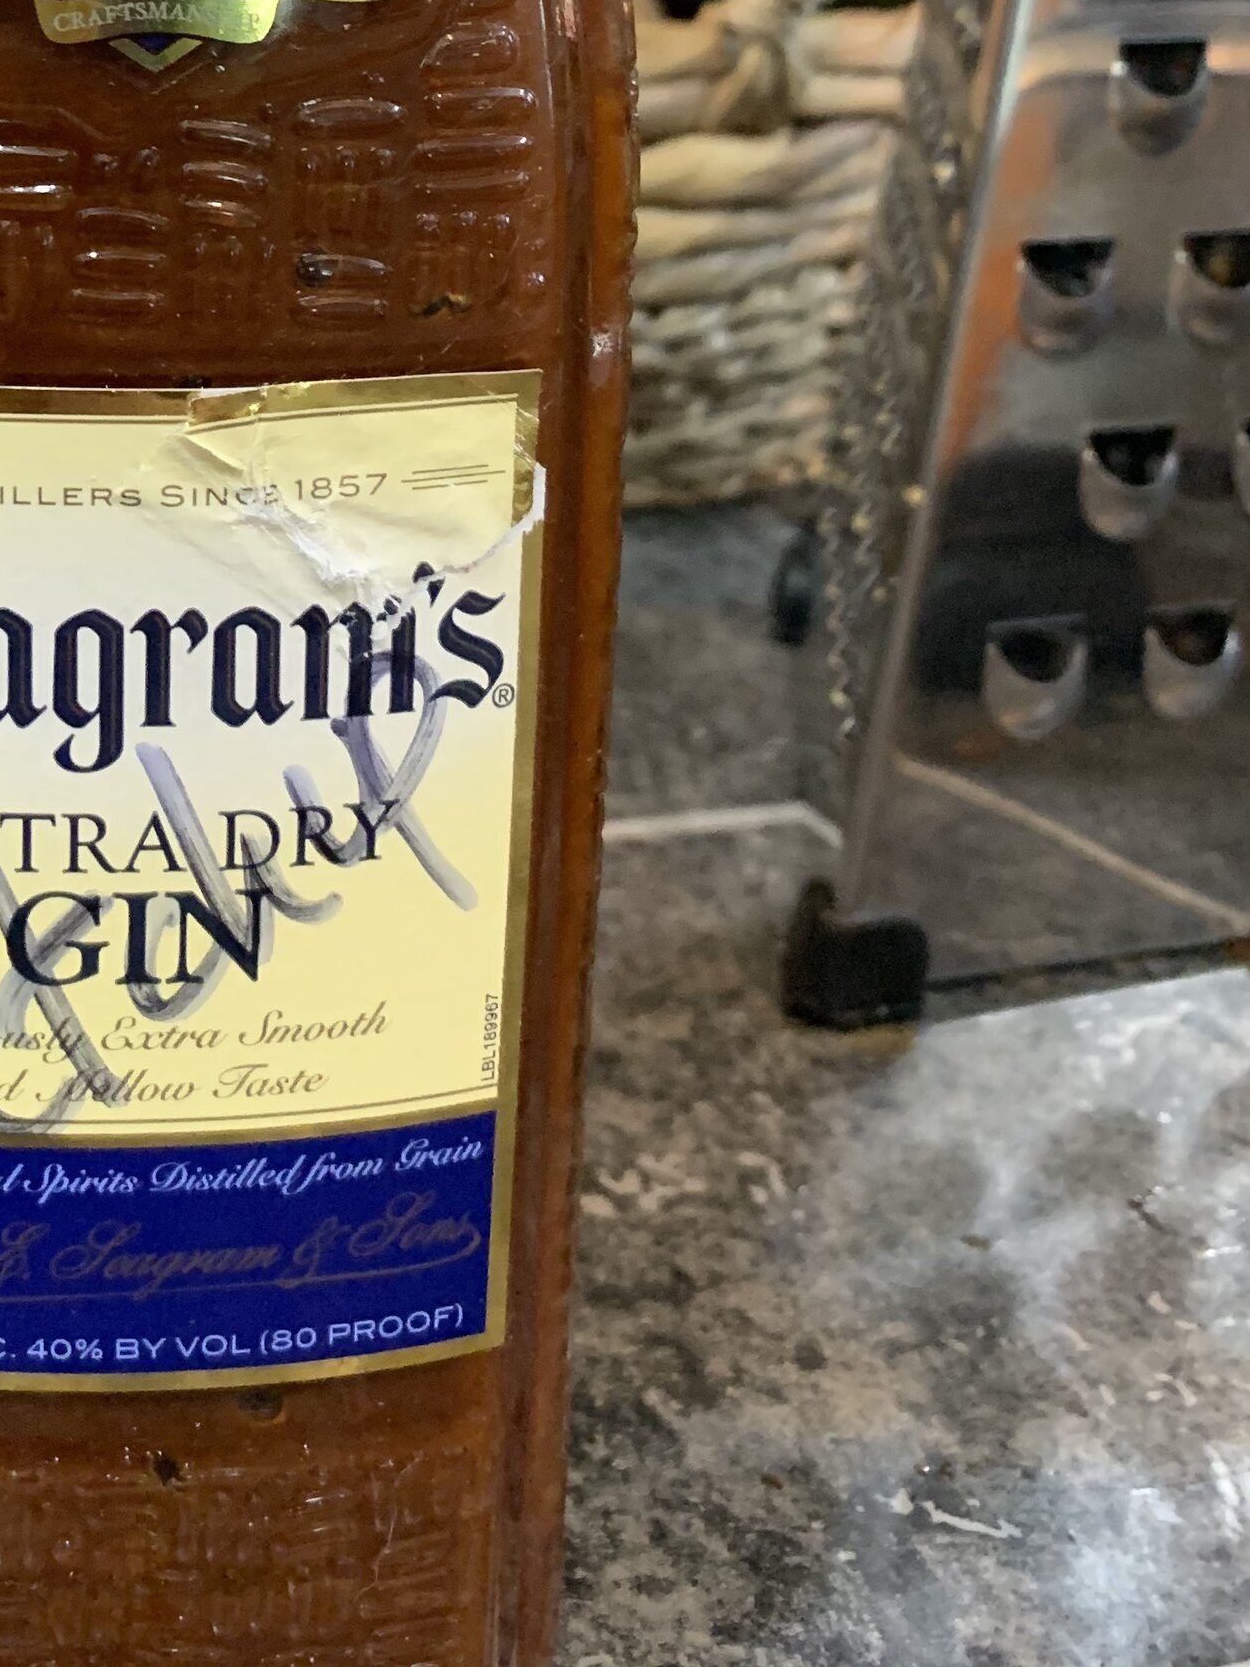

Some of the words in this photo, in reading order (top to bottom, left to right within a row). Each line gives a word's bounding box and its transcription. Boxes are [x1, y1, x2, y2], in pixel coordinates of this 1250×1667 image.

[295, 472, 388, 502] 1857
[219, 798, 400, 871] DRY
[5, 889, 273, 986] GIN
[100, 1015, 224, 1051] Extra
[238, 1000, 389, 1048] Smooth
[481, 993, 499, 1083] LBL189967
[36, 1067, 198, 1103] Mellow
[212, 1063, 329, 1099] Taste
[23, 1162, 141, 1205] Spirits
[150, 1154, 307, 1196] Distilled
[300, 1151, 385, 1190] from
[394, 1135, 484, 1174] Grain
[50, 1219, 282, 1301] Seagram
[350, 1190, 482, 1260] Sons
[26, 1338, 104, 1360] 40%
[115, 1337, 166, 1360] BY
[175, 1334, 251, 1358] VOL
[259, 1328, 318, 1356] (80
[328, 1302, 464, 1345] PROOF)
